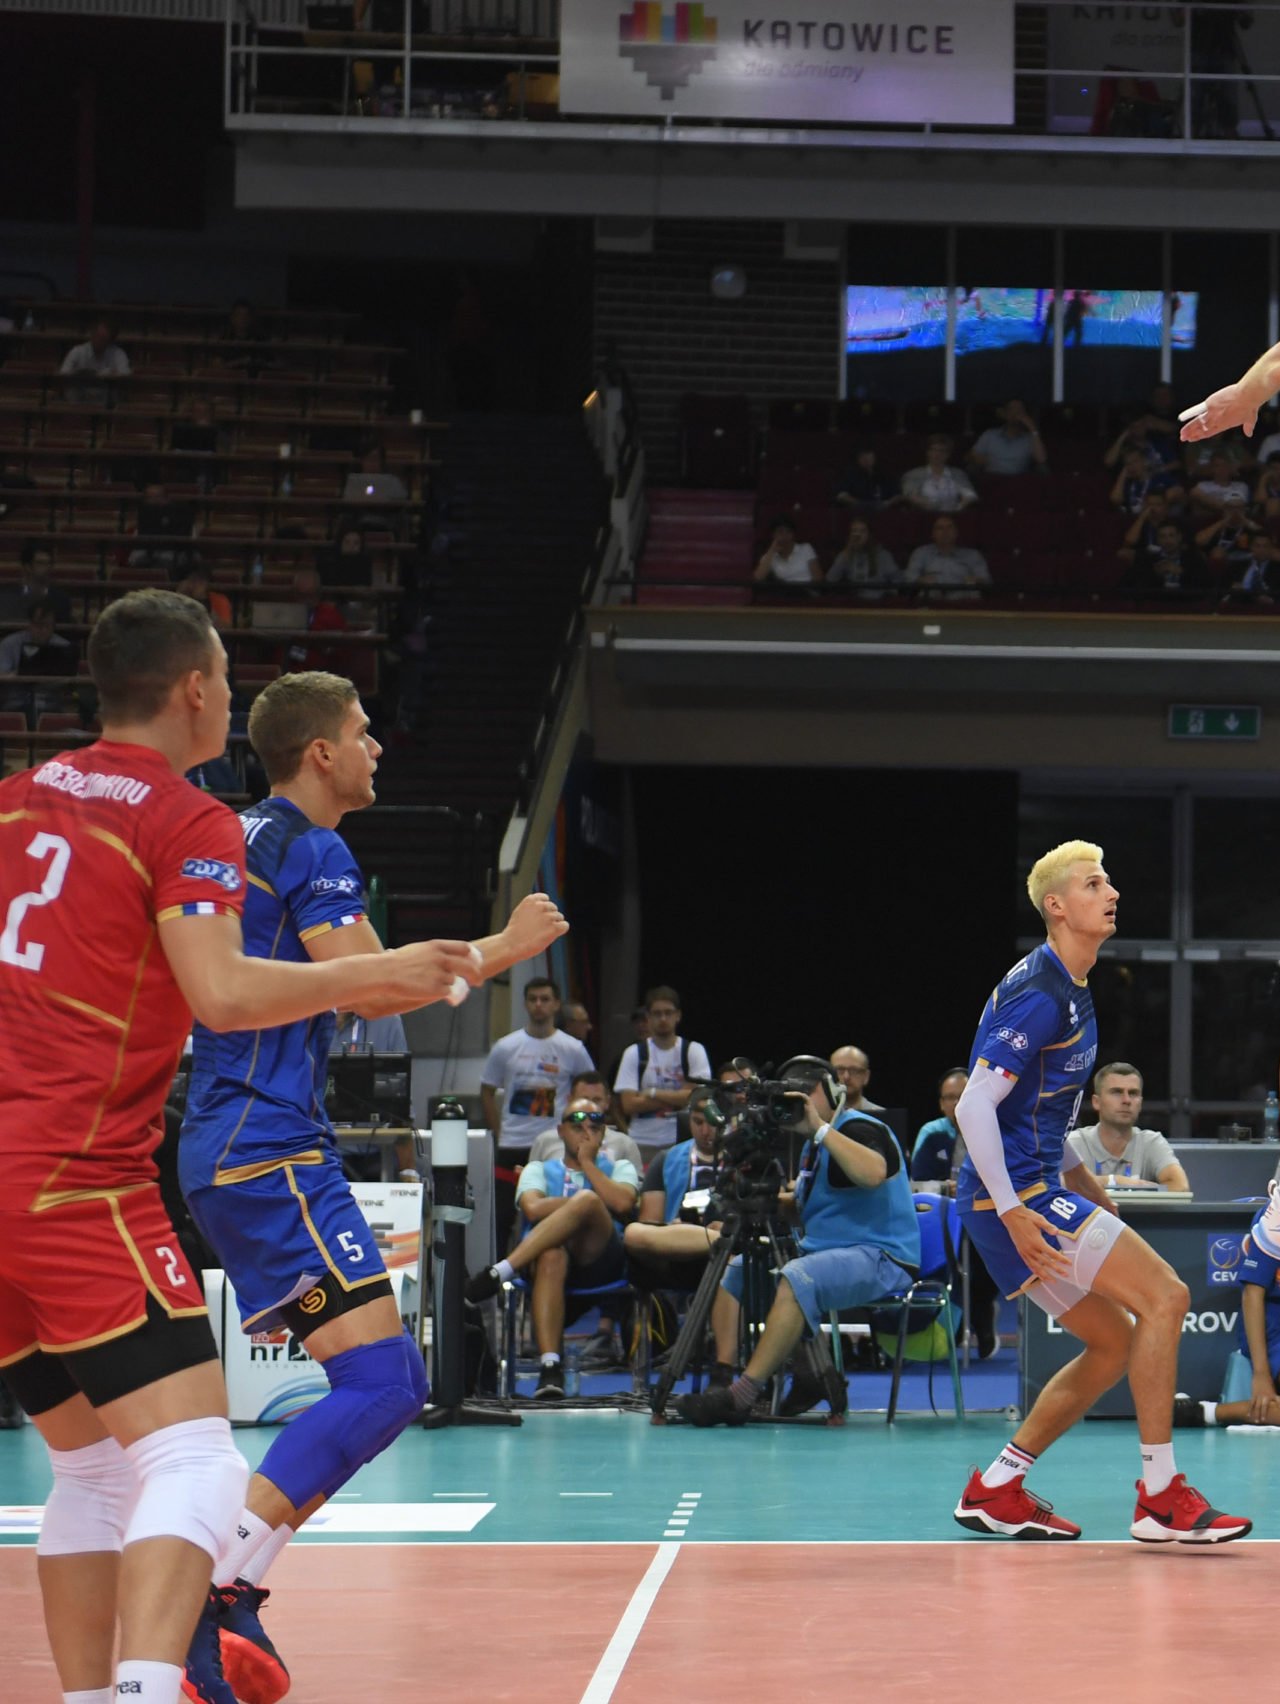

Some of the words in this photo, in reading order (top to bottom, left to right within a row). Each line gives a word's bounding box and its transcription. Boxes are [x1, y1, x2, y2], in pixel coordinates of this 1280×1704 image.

[743, 18, 955, 55] KATOWICE
[779, 60, 865, 83] odmiany
[0, 831, 72, 972] 2
[1050, 1197, 1078, 1221] 18
[337, 1231, 364, 1262] 5
[156, 1246, 185, 1287] 2
[1212, 1271, 1239, 1283] CEV
